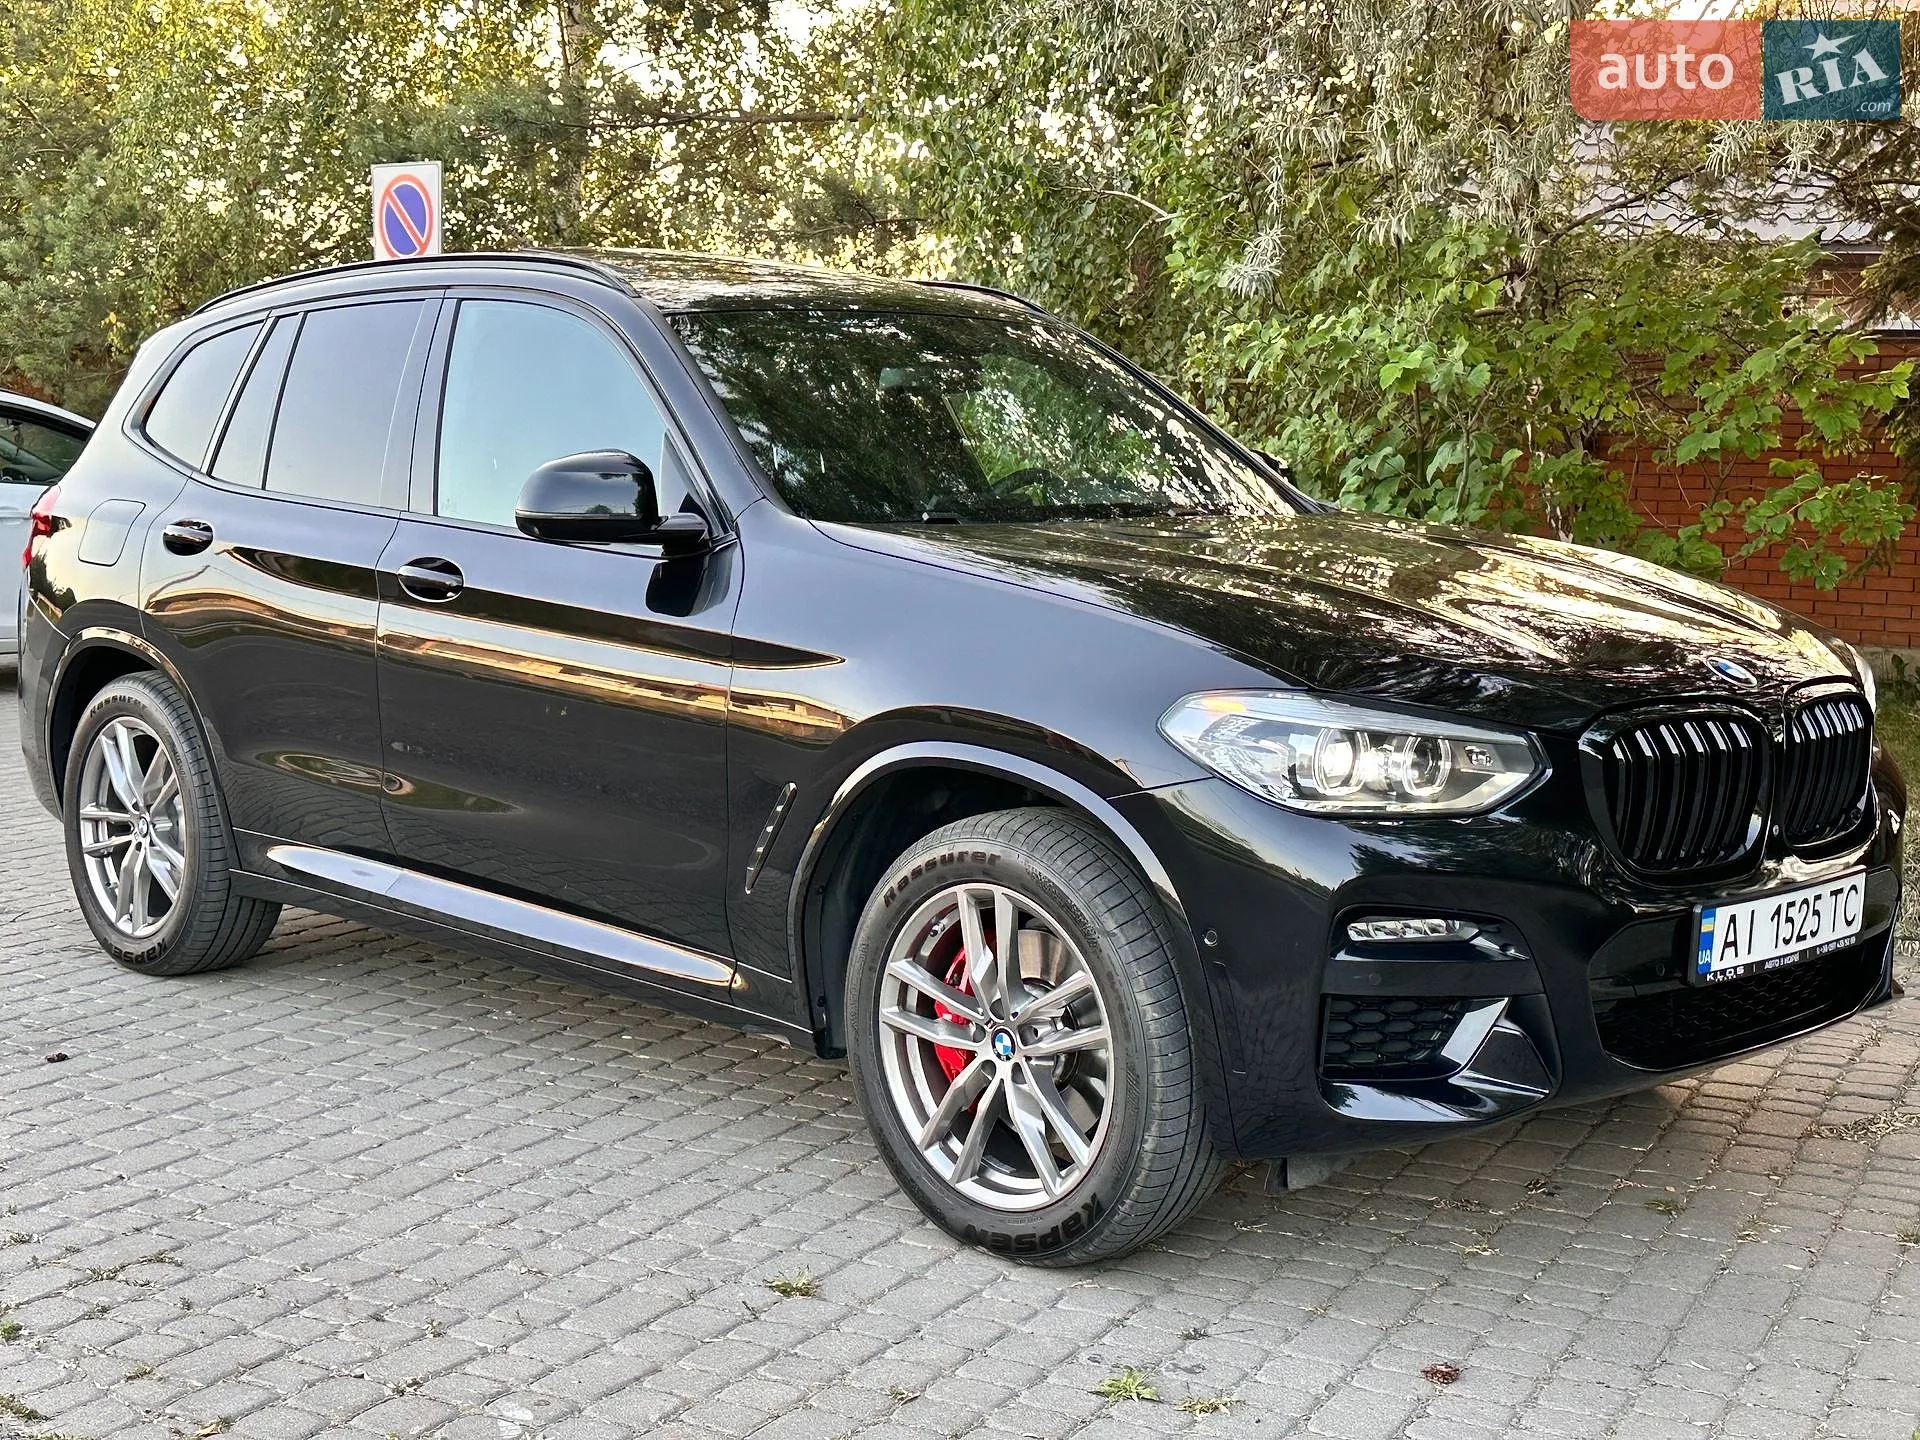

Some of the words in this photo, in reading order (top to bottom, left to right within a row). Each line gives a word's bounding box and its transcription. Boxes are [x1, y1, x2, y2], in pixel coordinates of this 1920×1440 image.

[1719, 909, 1756, 962] AI
[1770, 893, 1823, 950] 1525
[1829, 883, 1860, 934] TC
[1698, 950, 1712, 966] UA
[1706, 965, 1745, 982] KLOS
